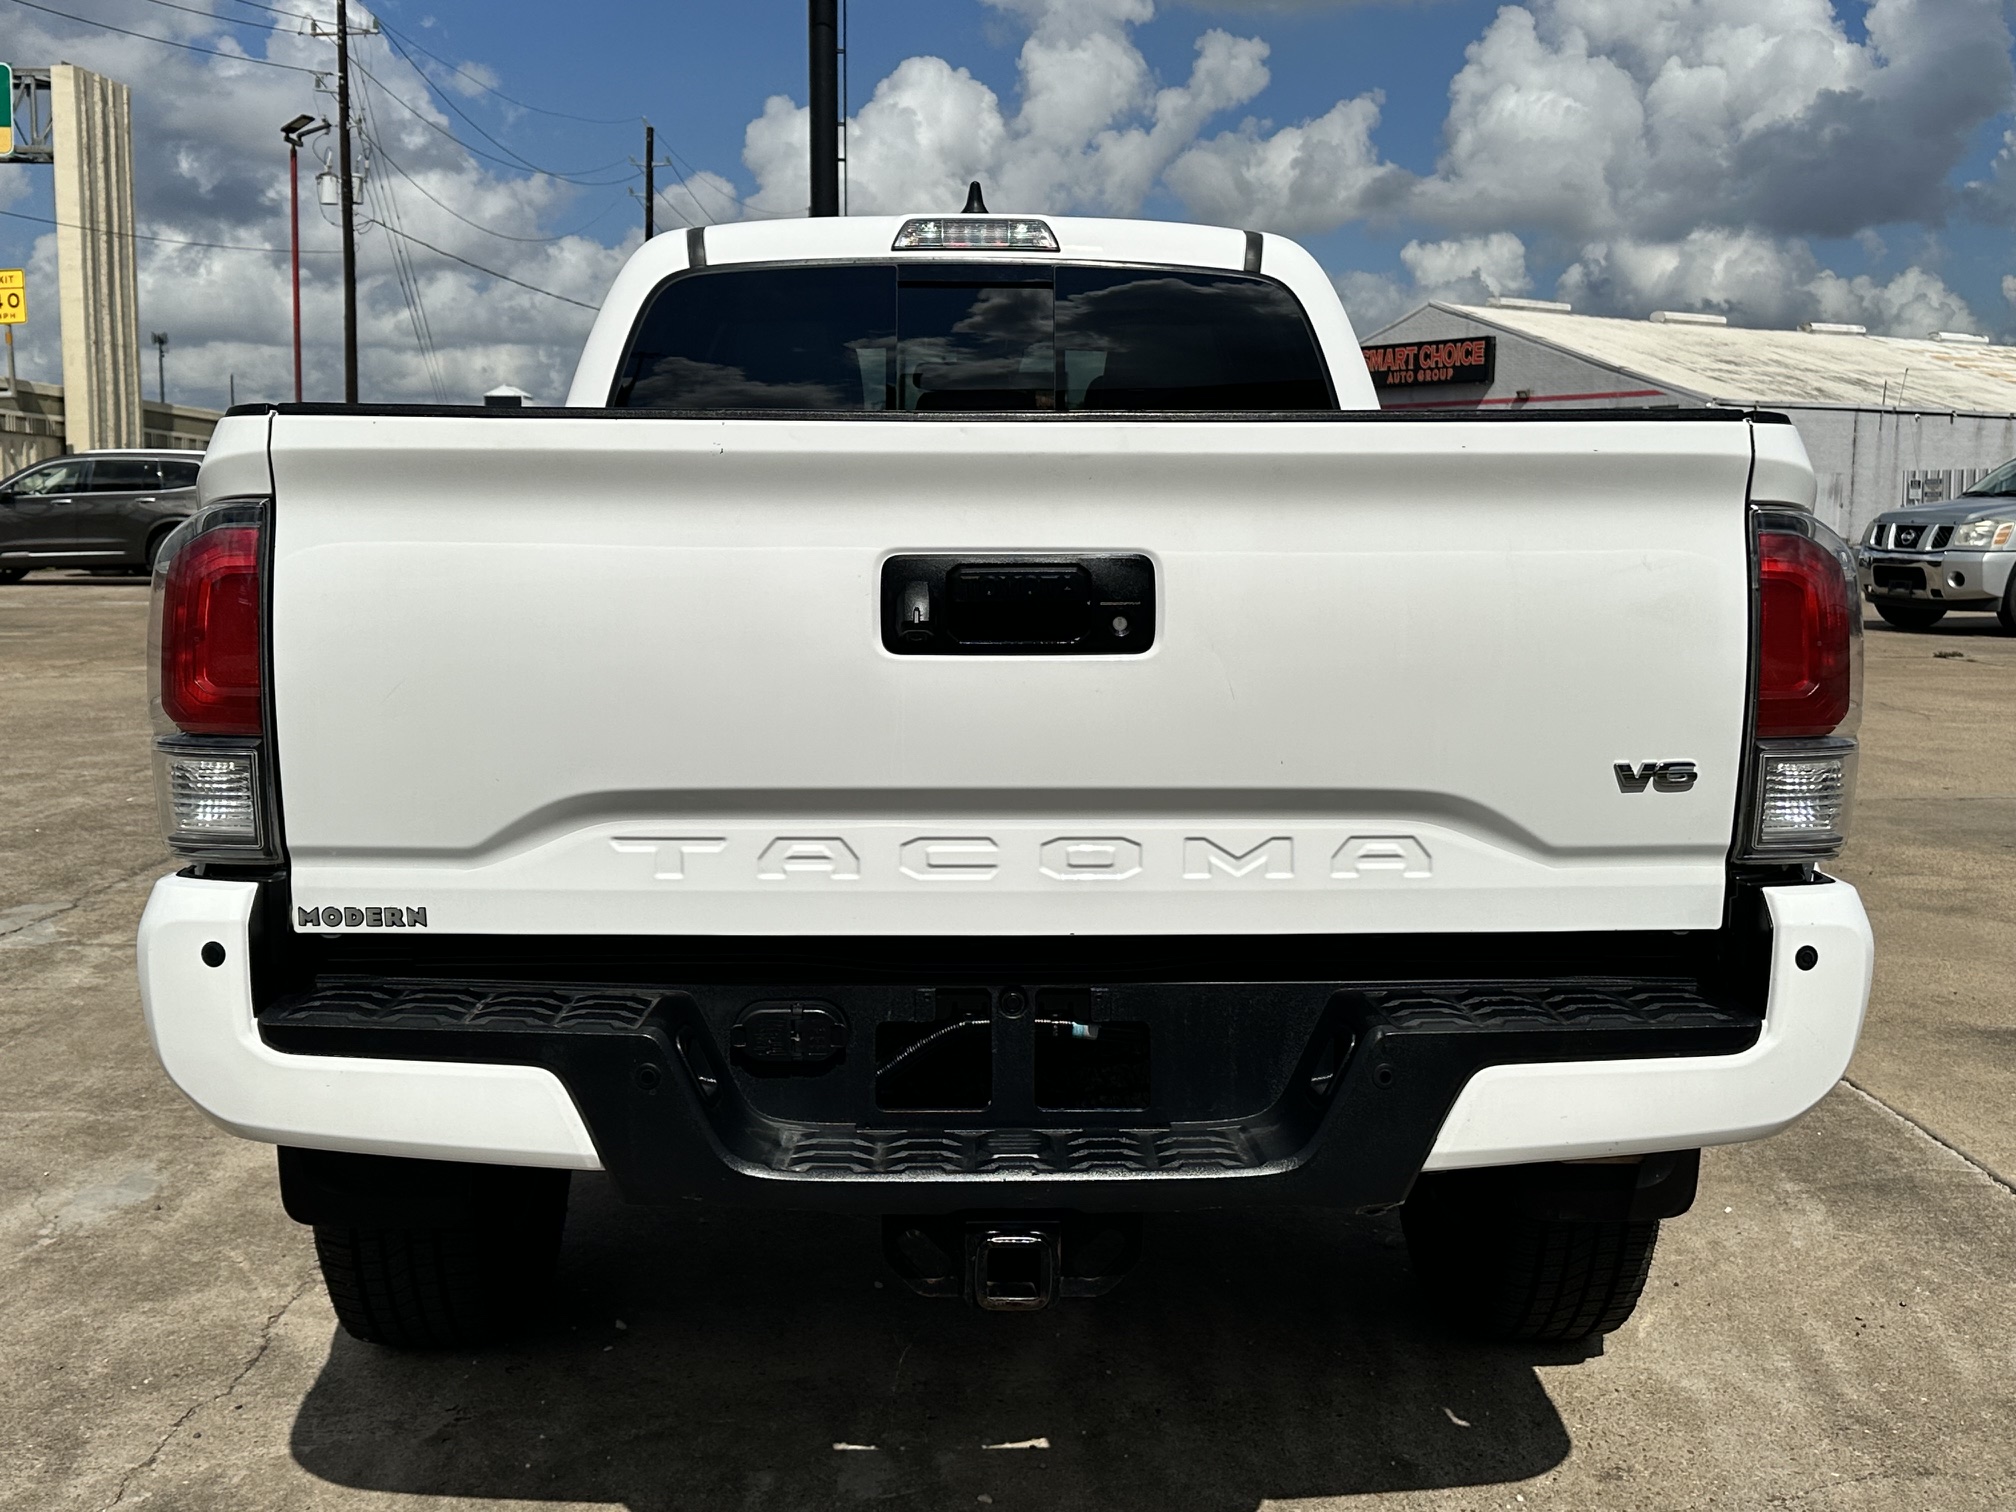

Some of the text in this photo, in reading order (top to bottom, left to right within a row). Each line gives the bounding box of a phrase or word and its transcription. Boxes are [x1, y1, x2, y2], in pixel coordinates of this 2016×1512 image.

[0, 292, 20, 309] 0
[0, 312, 16, 320] PH
[1419, 341, 1485, 369] CHOICE
[1386, 368, 1453, 384] AUTO GROUP
[1613, 761, 1698, 793] V6
[609, 835, 1432, 880] TACOMA
[298, 906, 427, 927] MODERN
